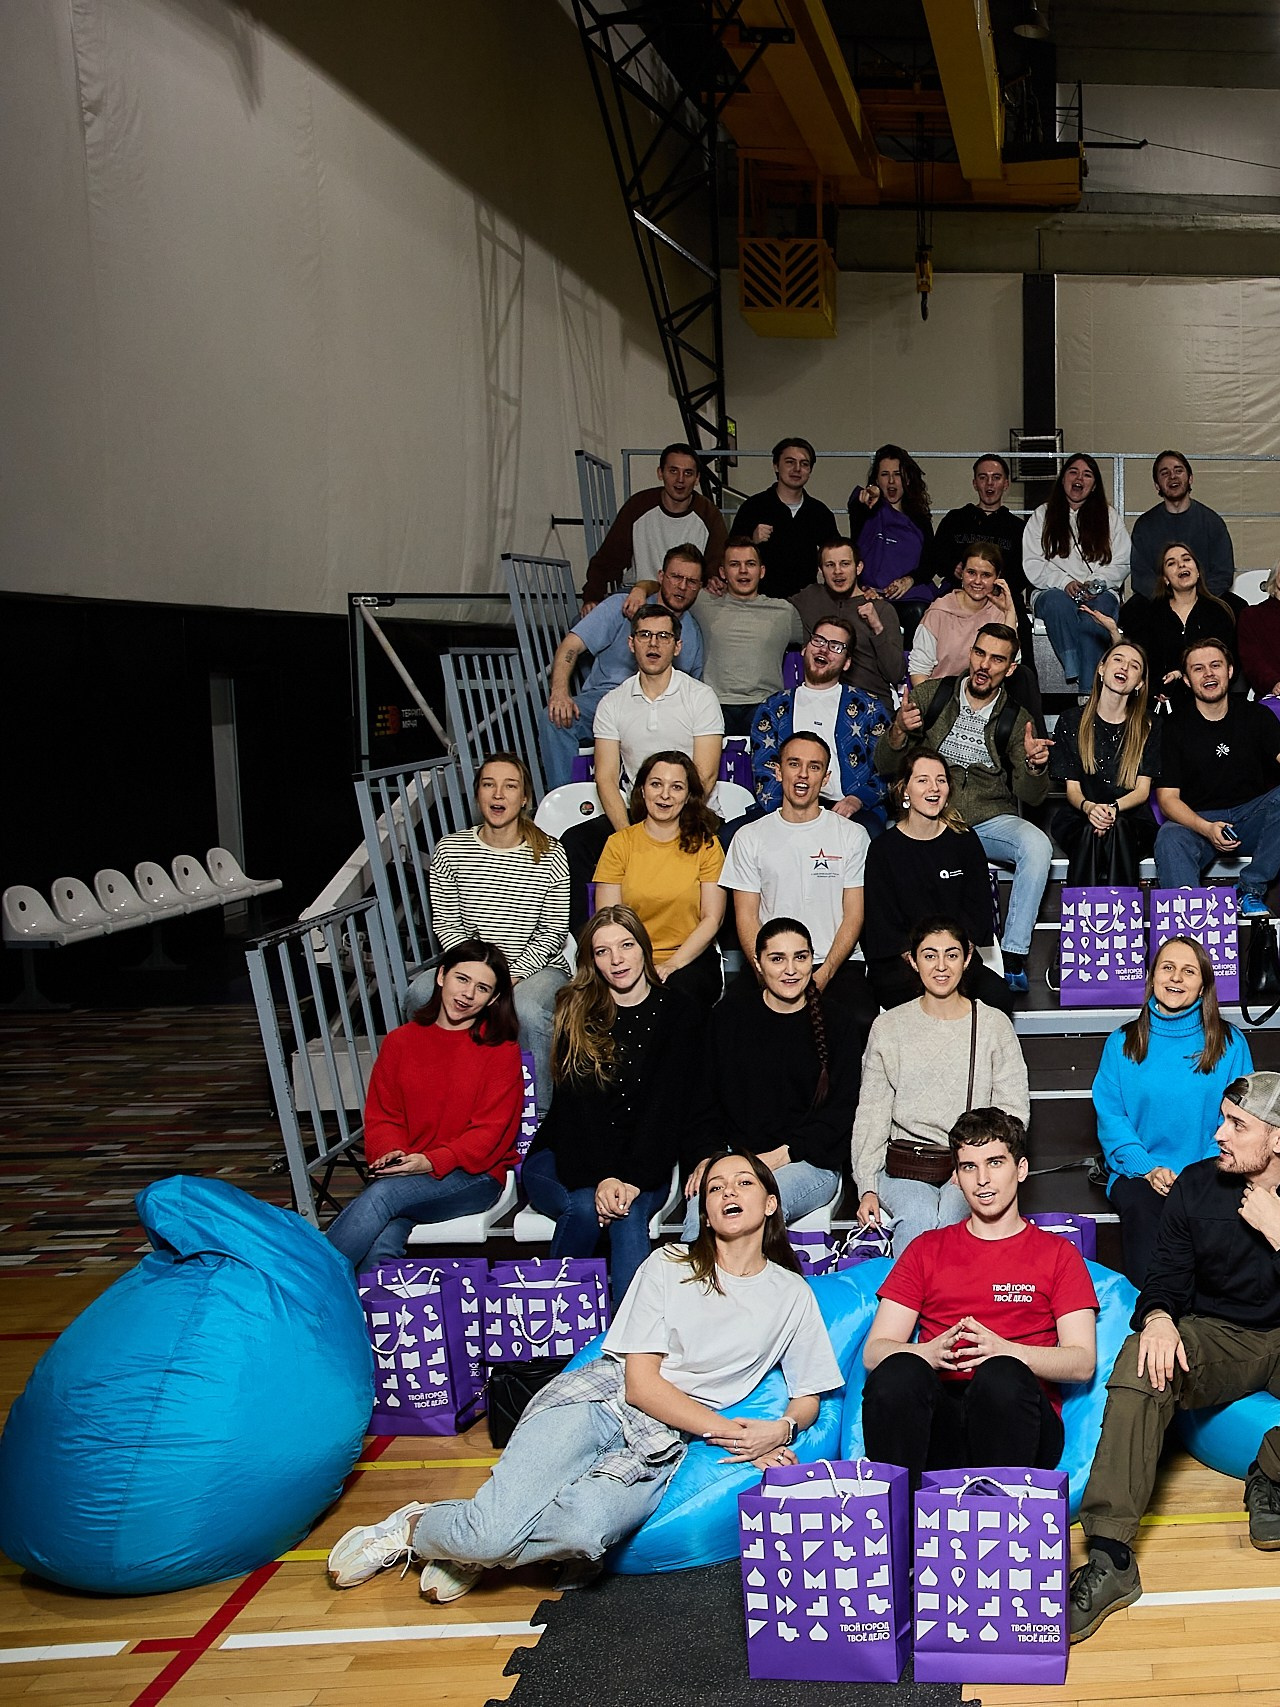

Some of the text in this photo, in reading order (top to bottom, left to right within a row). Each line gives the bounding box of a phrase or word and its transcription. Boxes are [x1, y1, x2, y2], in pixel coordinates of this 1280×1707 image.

[992, 1283, 1036, 1293] ТВОЙ ГОРОД
[993, 1293, 1033, 1303] ТВОЁ ДЕЛО
[408, 1390, 448, 1401] ТВОЙ ГОРОД
[839, 1621, 890, 1632] ТВОЙ ГОРОД
[1010, 1622, 1060, 1633] ТВОЙ ГОРОД
[846, 1632, 890, 1642] ТВОЁ ДЕЛО
[1017, 1633, 1061, 1644] ТВОЁ ДЕЛО
